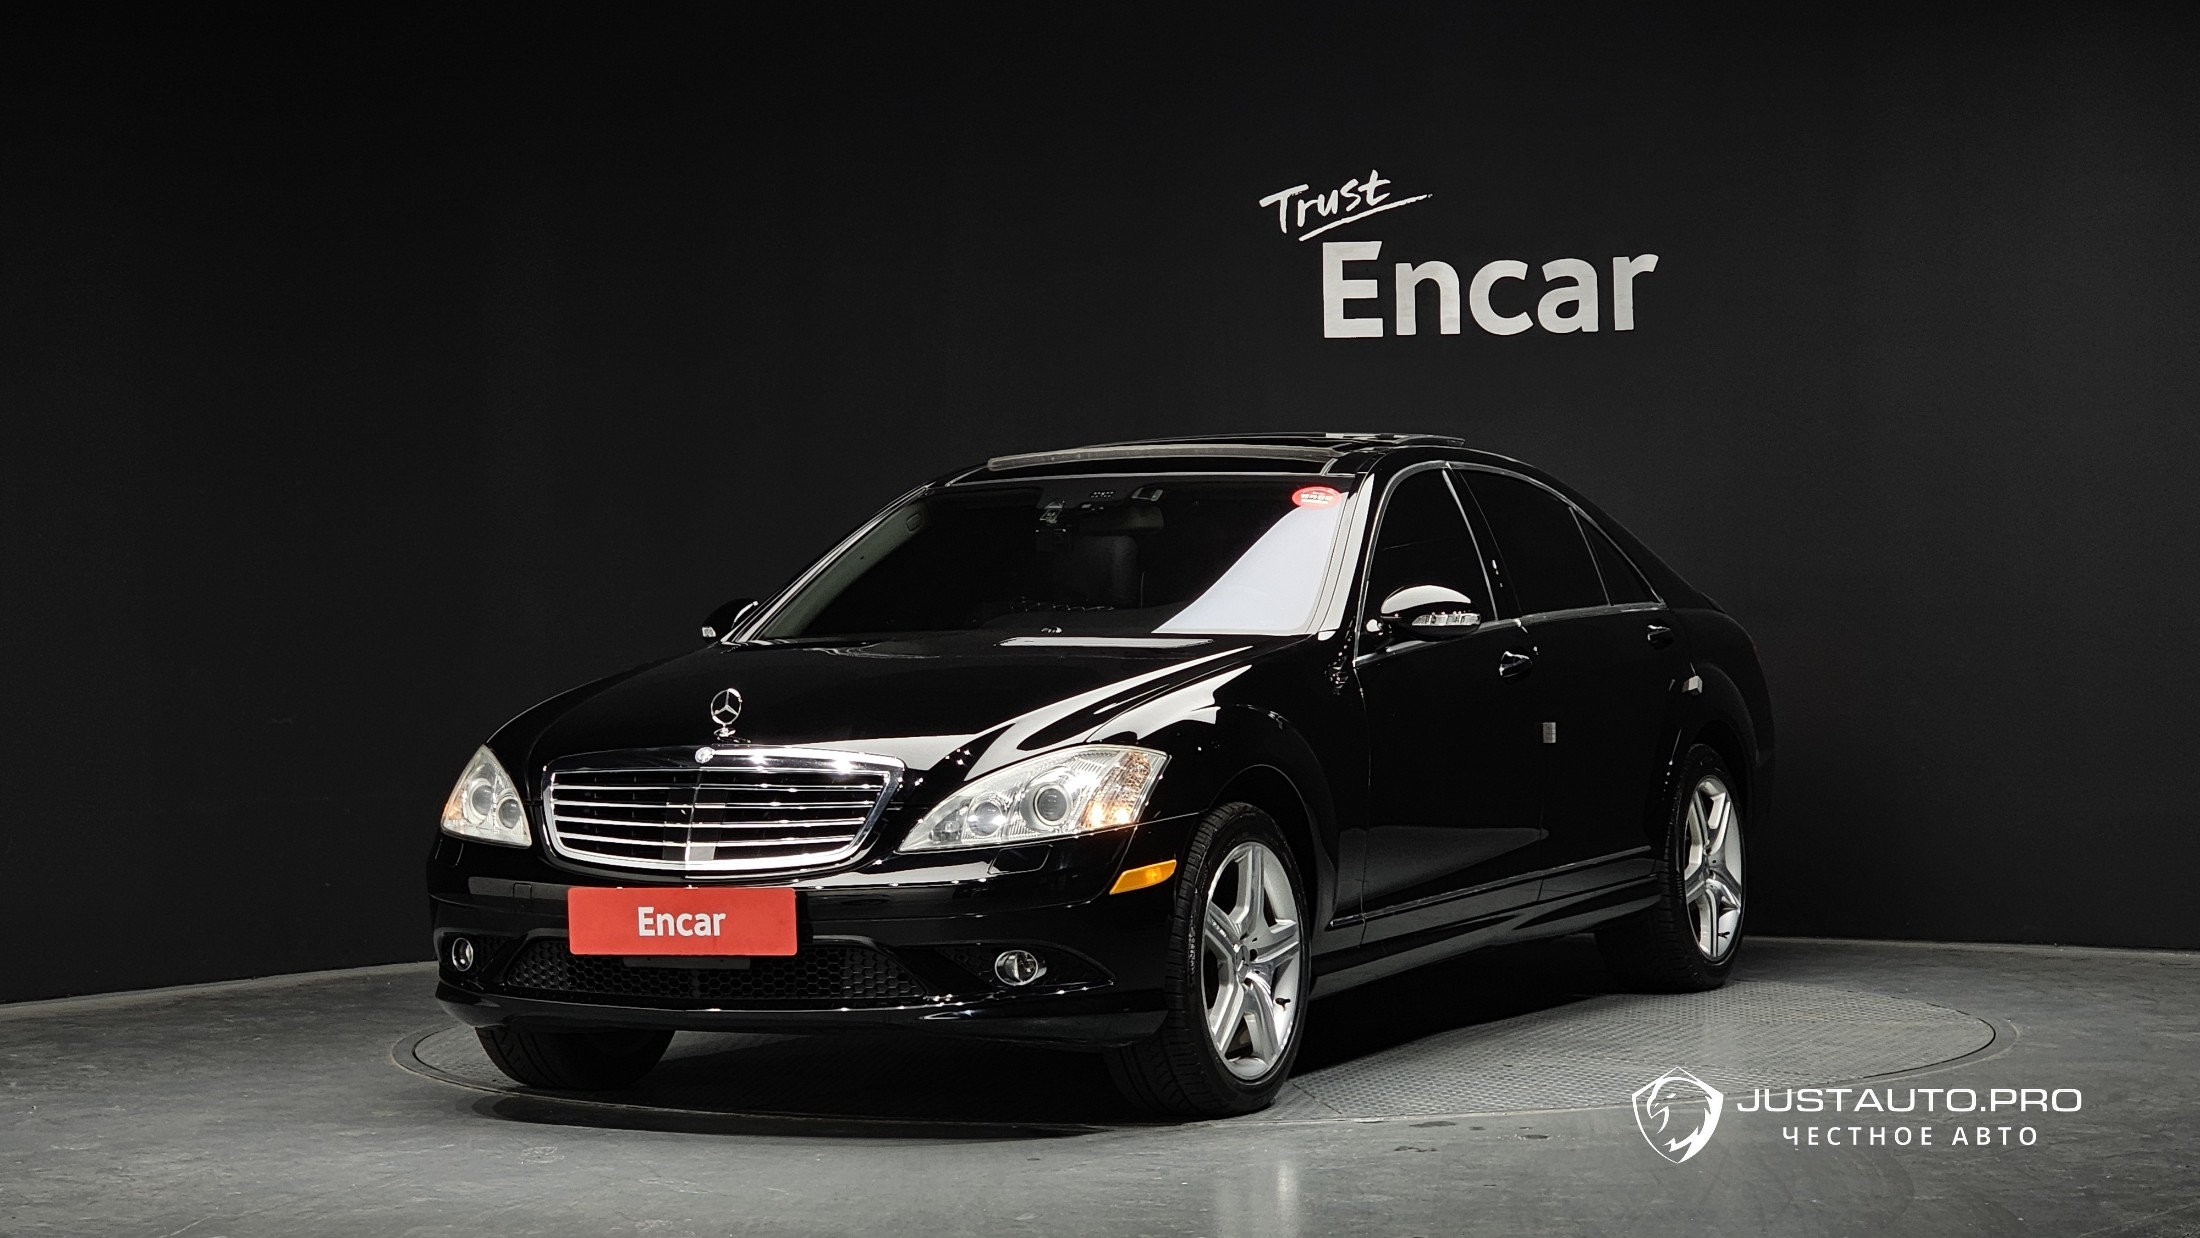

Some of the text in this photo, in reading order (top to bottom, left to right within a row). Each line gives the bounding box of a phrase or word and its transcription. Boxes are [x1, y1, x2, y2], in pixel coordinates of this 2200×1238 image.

[1259, 169, 1391, 233] Trust
[1322, 240, 1659, 339] Encar
[637, 906, 727, 937] Encar
